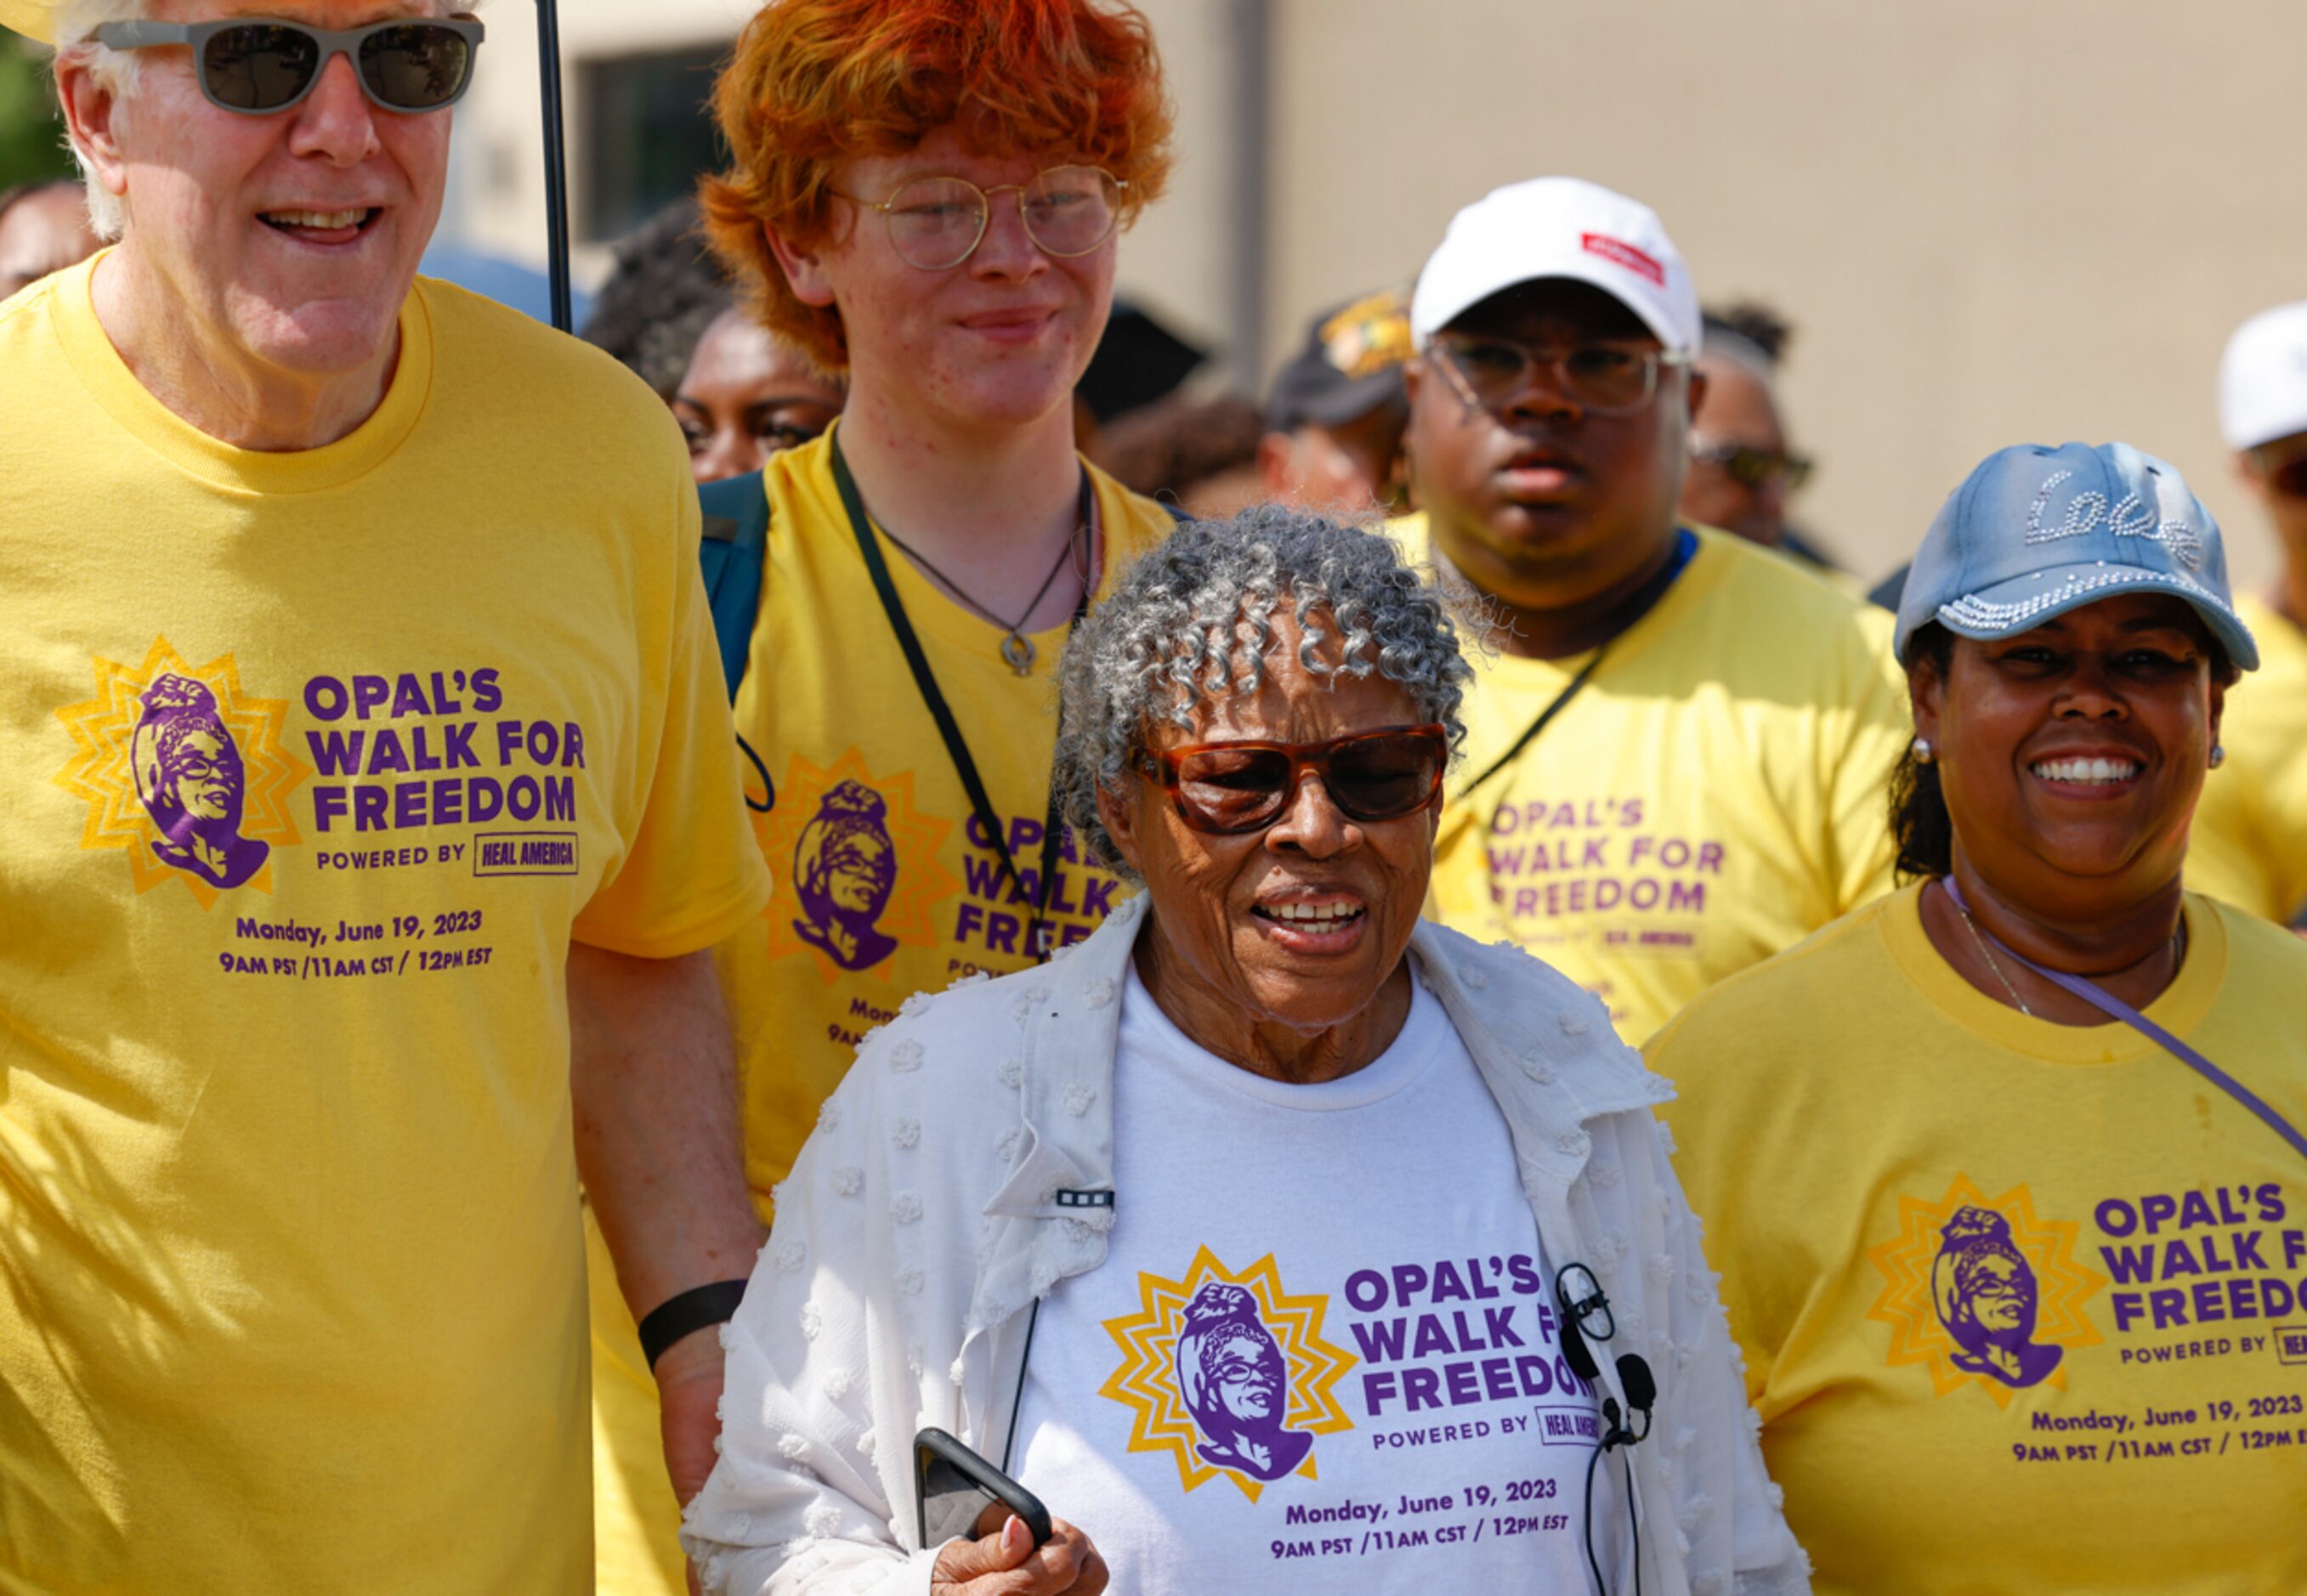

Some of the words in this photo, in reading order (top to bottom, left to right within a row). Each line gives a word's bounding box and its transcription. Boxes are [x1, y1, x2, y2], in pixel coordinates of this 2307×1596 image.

[303, 668, 502, 722] OPAL'S
[305, 722, 481, 777] WALK
[496, 720, 585, 768] FOR
[313, 774, 576, 832] FREEDOM
[1492, 798, 1643, 836] OPAL'S
[317, 846, 428, 869] POWERED
[438, 844, 465, 863] BY
[482, 842, 517, 866] HEAL
[520, 841, 574, 865] AMERICA
[1487, 836, 1609, 876] WALK
[1629, 836, 1725, 875] FOR
[963, 853, 1119, 919] WALK
[236, 917, 327, 948] Monday,
[335, 920, 383, 942] June
[392, 915, 425, 939] 19,
[434, 910, 482, 936] 2023
[219, 952, 268, 976] 9AM
[273, 958, 297, 976] PST
[371, 956, 394, 975] CST
[419, 950, 463, 971] 12PM
[467, 947, 493, 966] EST
[2094, 1183, 2287, 1238] OPAL'S
[2099, 1230, 2270, 1285] WALK
[1345, 1254, 1540, 1313] OPAL'S
[1349, 1305, 1526, 1364] WALK
[2121, 1338, 2231, 1364] POWERED
[2241, 1335, 2266, 1354] BY
[1373, 1421, 1490, 1450] POWERED
[1501, 1416, 1528, 1435] BY
[1545, 1414, 1574, 1436] HEAL
[2031, 1408, 2134, 1435] Monday,
[2144, 1406, 2197, 1428] June
[2207, 1401, 2241, 1423] 19,
[2248, 1395, 2304, 1418] 2023
[2012, 1443, 2060, 1463] 9AM
[2066, 1445, 2097, 1461] PST
[2180, 1438, 2212, 1456] CST
[2240, 1430, 2293, 1450] 12PM
[1285, 1499, 1389, 1525] Monday,
[1397, 1494, 1454, 1516] June
[1463, 1485, 1498, 1508] 19,
[1505, 1479, 1557, 1503] 2023
[1271, 1540, 1315, 1559] 9AM
[1321, 1537, 1353, 1556] PST
[1435, 1525, 1466, 1544] CST
[1493, 1515, 1539, 1537] 12PM
[1543, 1514, 1569, 1531] EST
